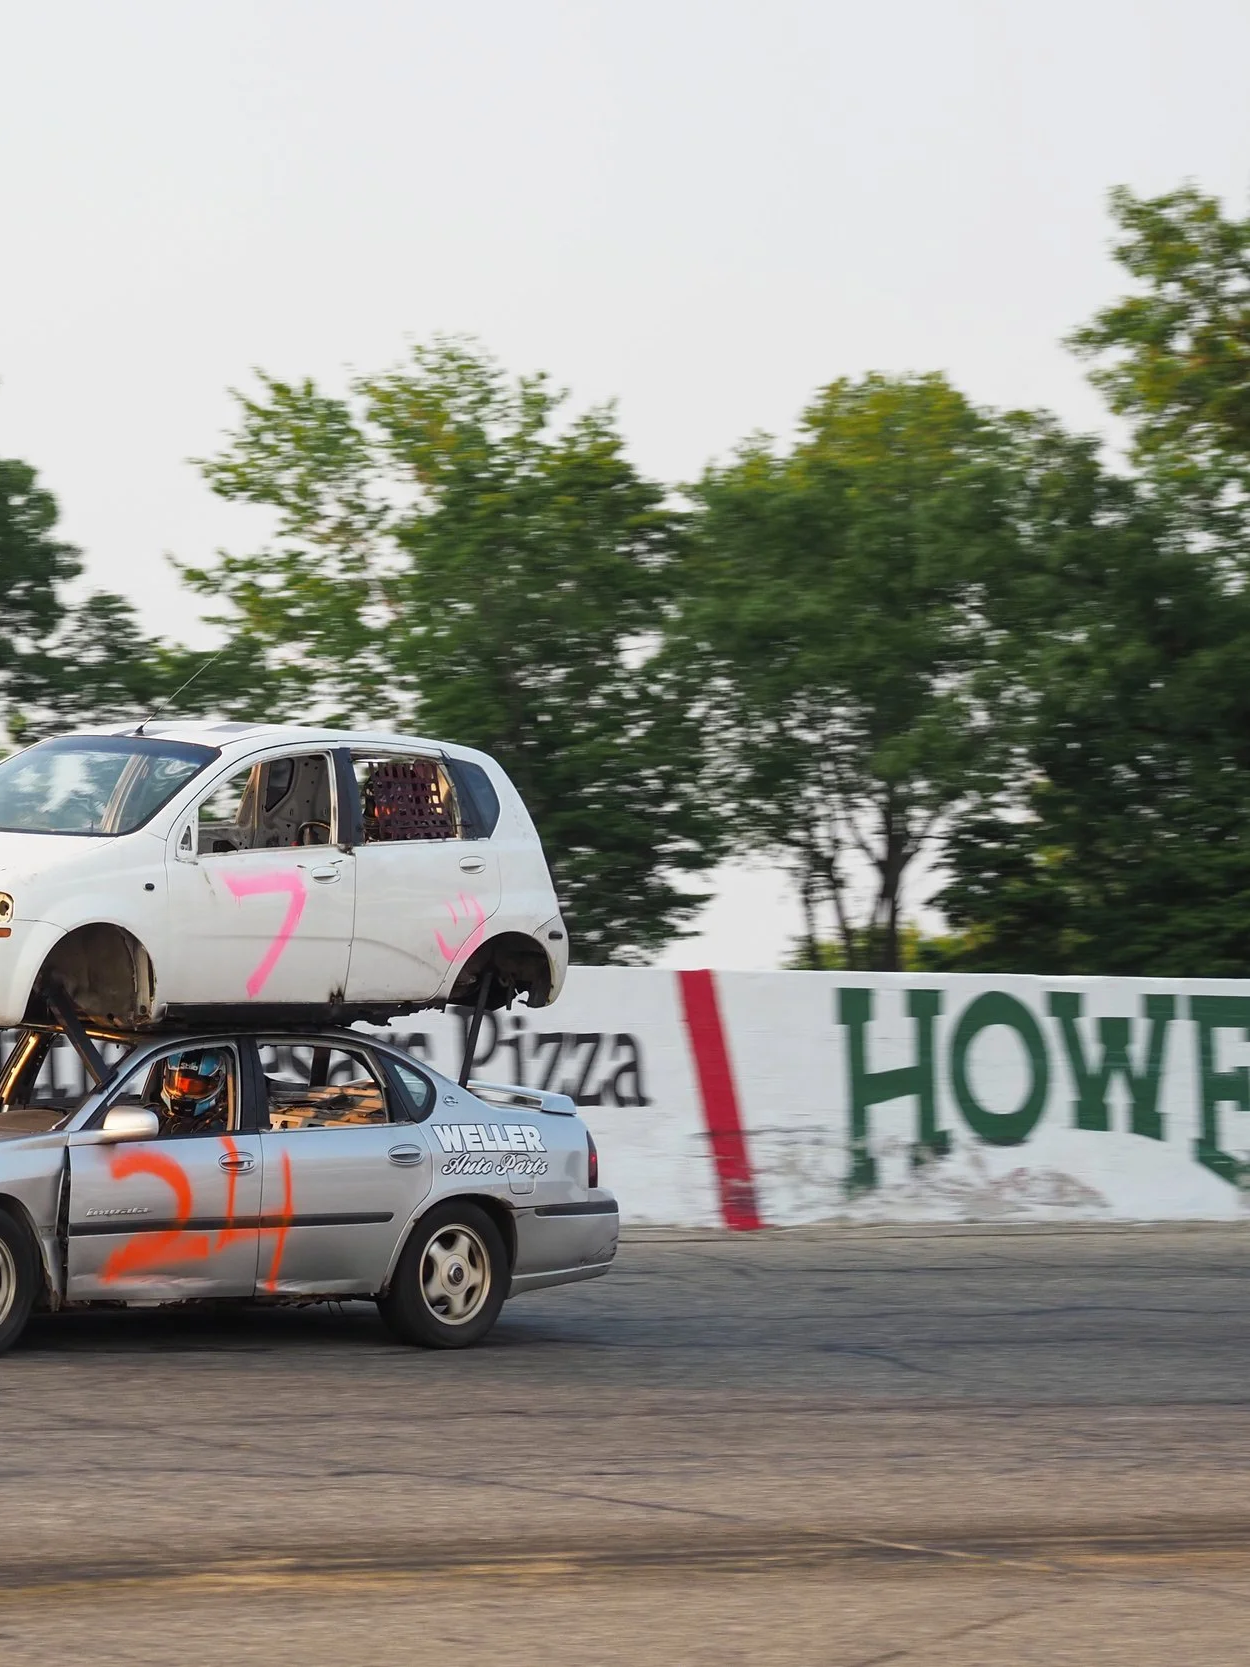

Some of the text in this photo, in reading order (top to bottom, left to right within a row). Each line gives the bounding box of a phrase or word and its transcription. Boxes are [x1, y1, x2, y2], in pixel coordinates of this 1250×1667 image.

[220, 868, 307, 998] 7
[451, 1006, 655, 1107] Pizza
[431, 1124, 547, 1153] WELLER
[441, 1153, 548, 1175] Auto Parts
[98, 1135, 293, 1293] 24
